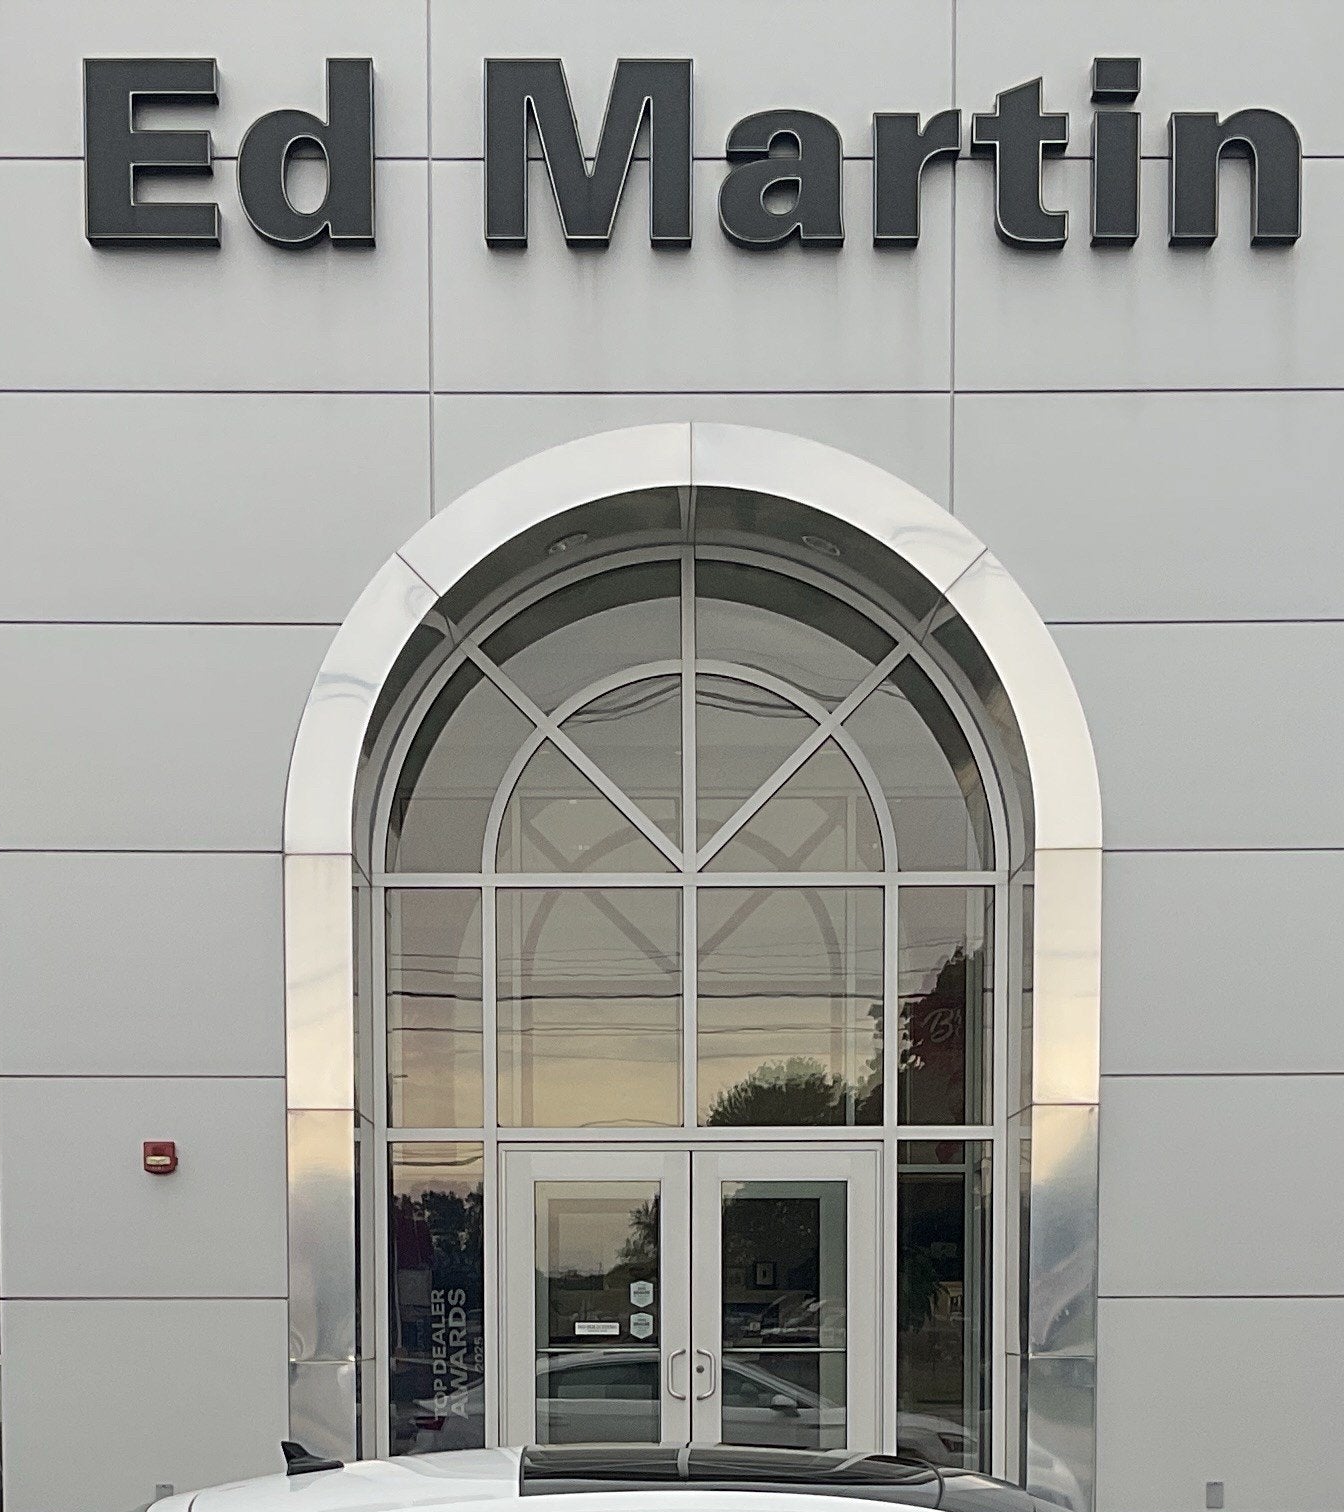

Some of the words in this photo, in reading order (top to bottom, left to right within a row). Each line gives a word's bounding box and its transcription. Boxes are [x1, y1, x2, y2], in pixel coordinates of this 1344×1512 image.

[84, 57, 376, 252] Ed
[485, 56, 1305, 252] Martin
[430, 1289, 447, 1375] DEALER
[447, 1288, 469, 1420] AWARDS
[473, 1336, 484, 1373] 2025
[433, 1378, 448, 1421] TOP
